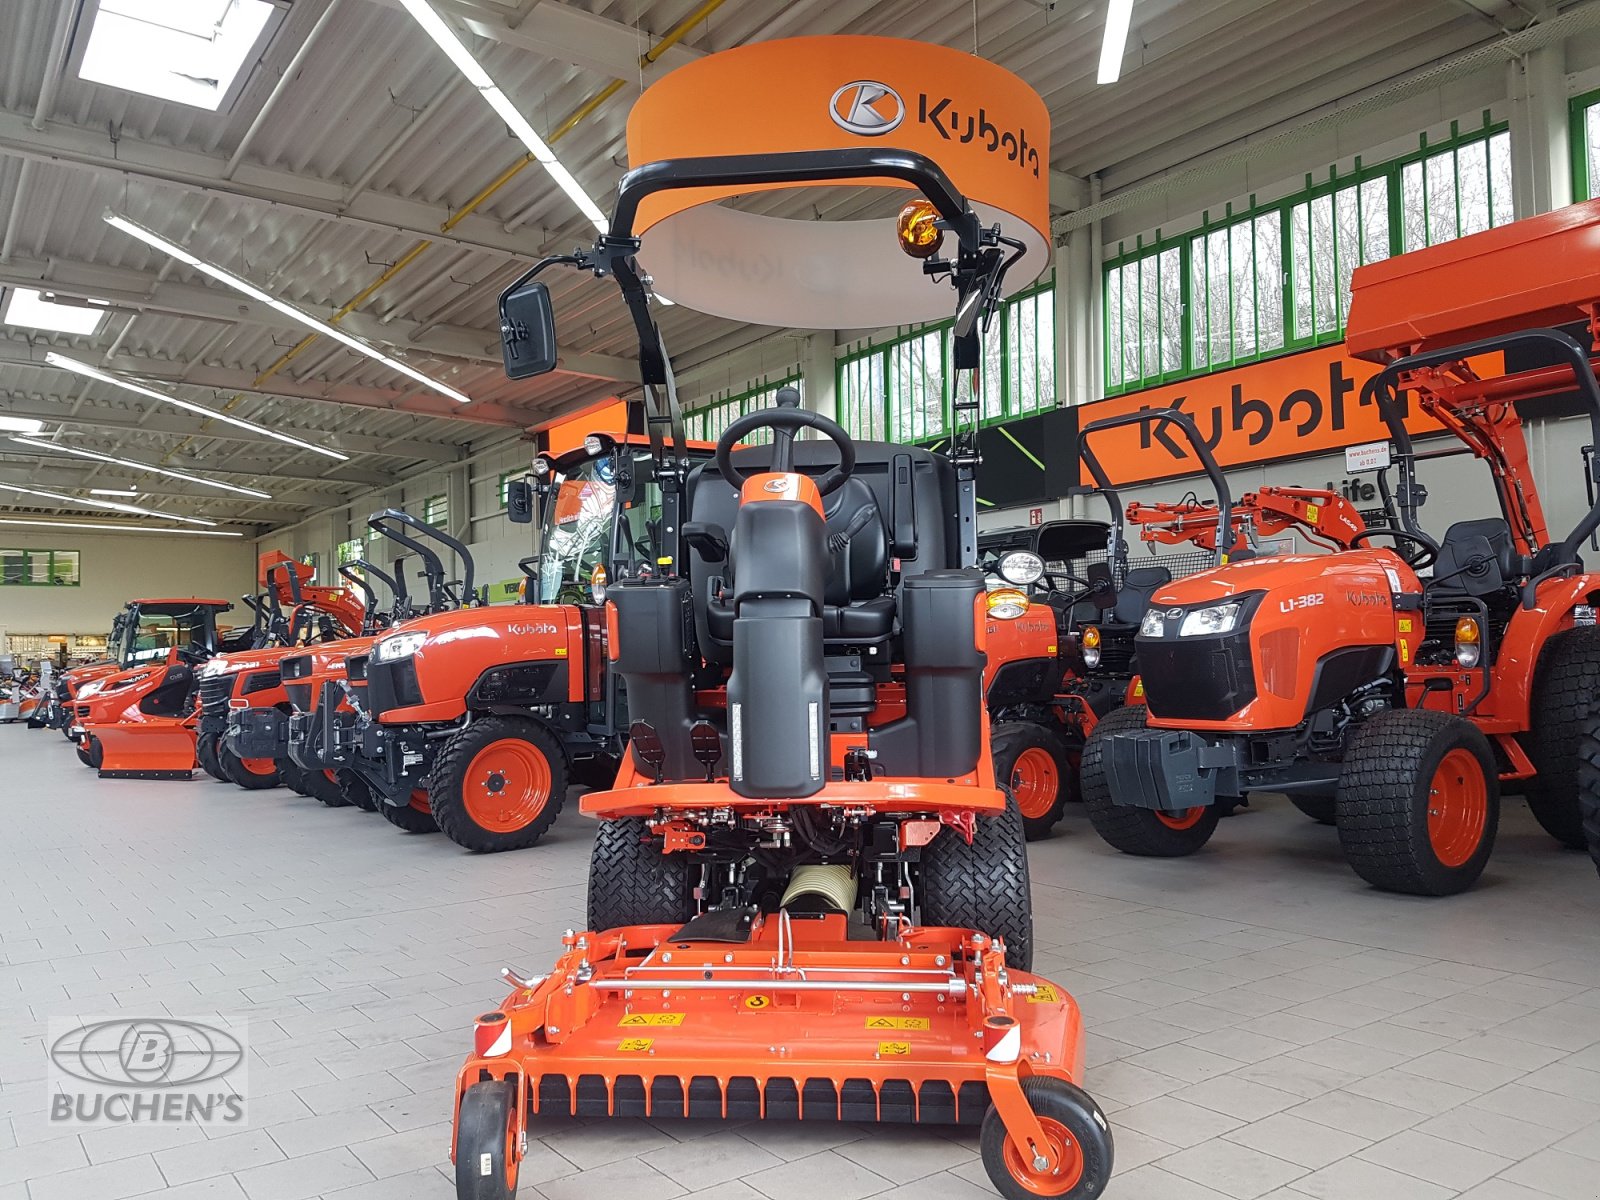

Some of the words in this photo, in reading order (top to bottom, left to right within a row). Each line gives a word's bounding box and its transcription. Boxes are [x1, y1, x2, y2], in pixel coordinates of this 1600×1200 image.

[918, 92, 1040, 180] Kubota
[1139, 360, 1410, 460] Kubota
[507, 623, 557, 635] Kubota
[1280, 593, 1325, 613] L1-382
